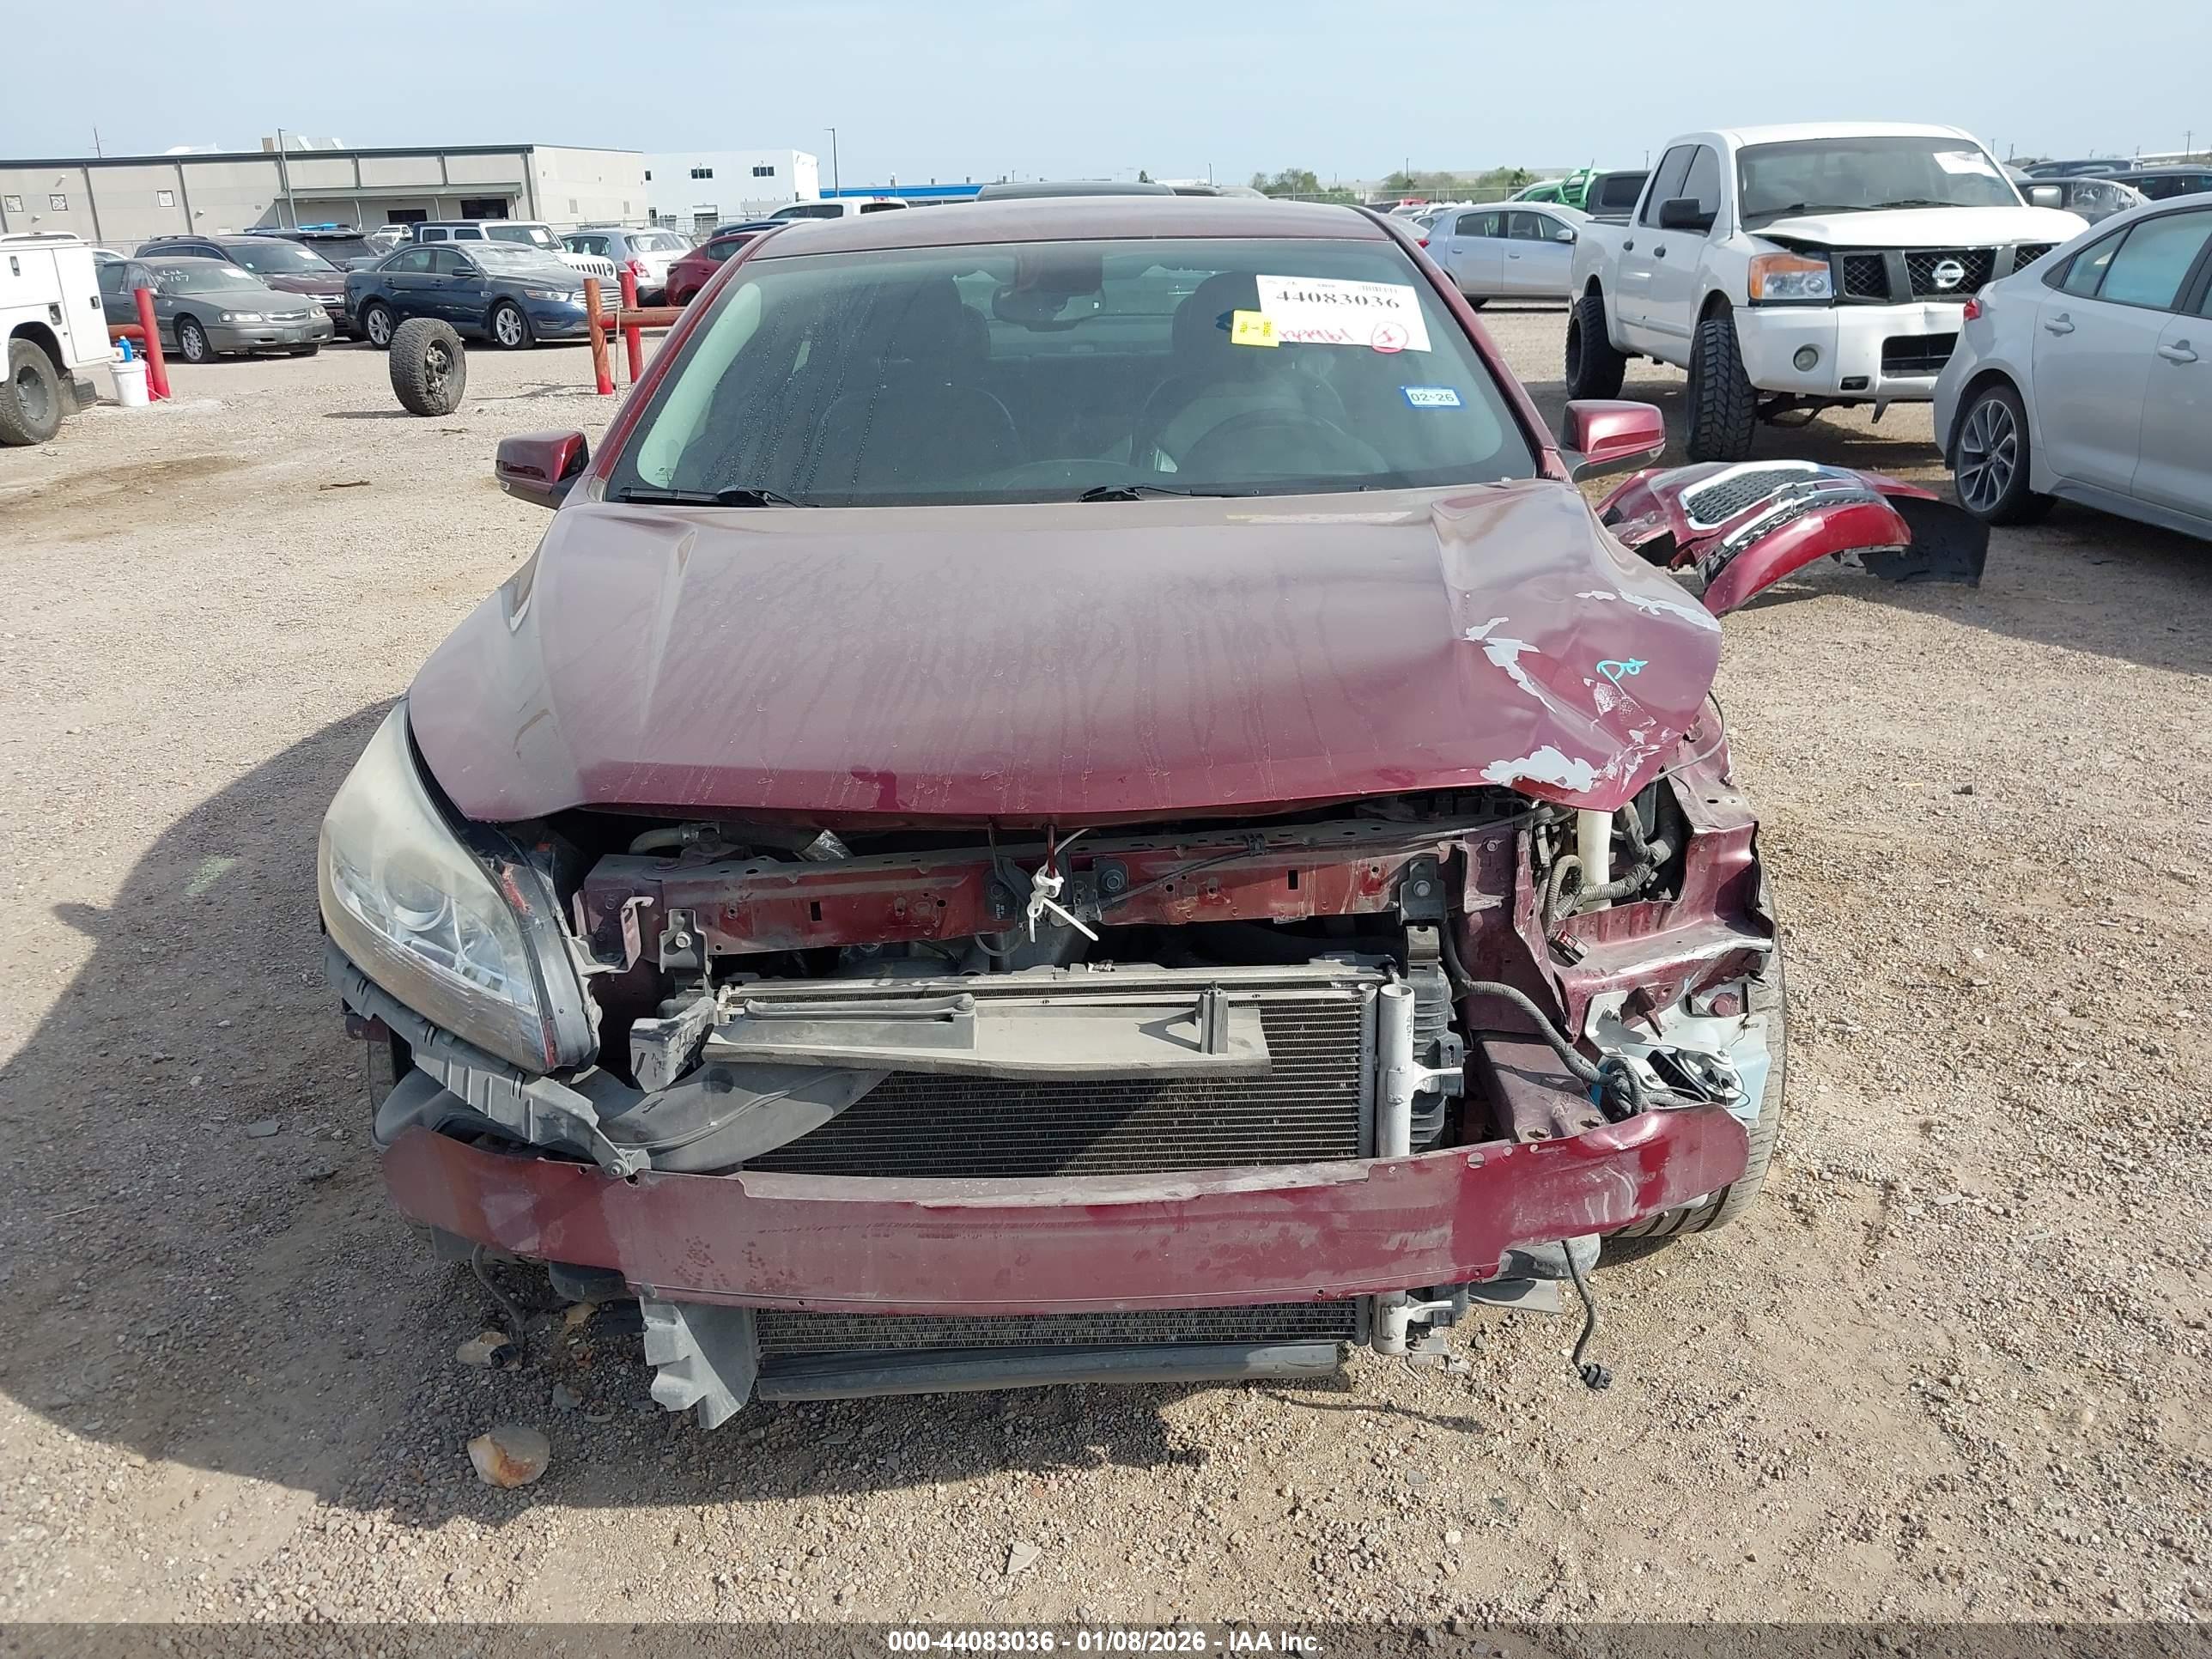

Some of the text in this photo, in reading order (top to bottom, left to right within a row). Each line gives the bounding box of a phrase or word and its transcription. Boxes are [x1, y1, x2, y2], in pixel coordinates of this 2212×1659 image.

[171, 274, 189, 283] 107
[1276, 290, 1400, 309] 44083036
[1410, 392, 1455, 402] 02-26
